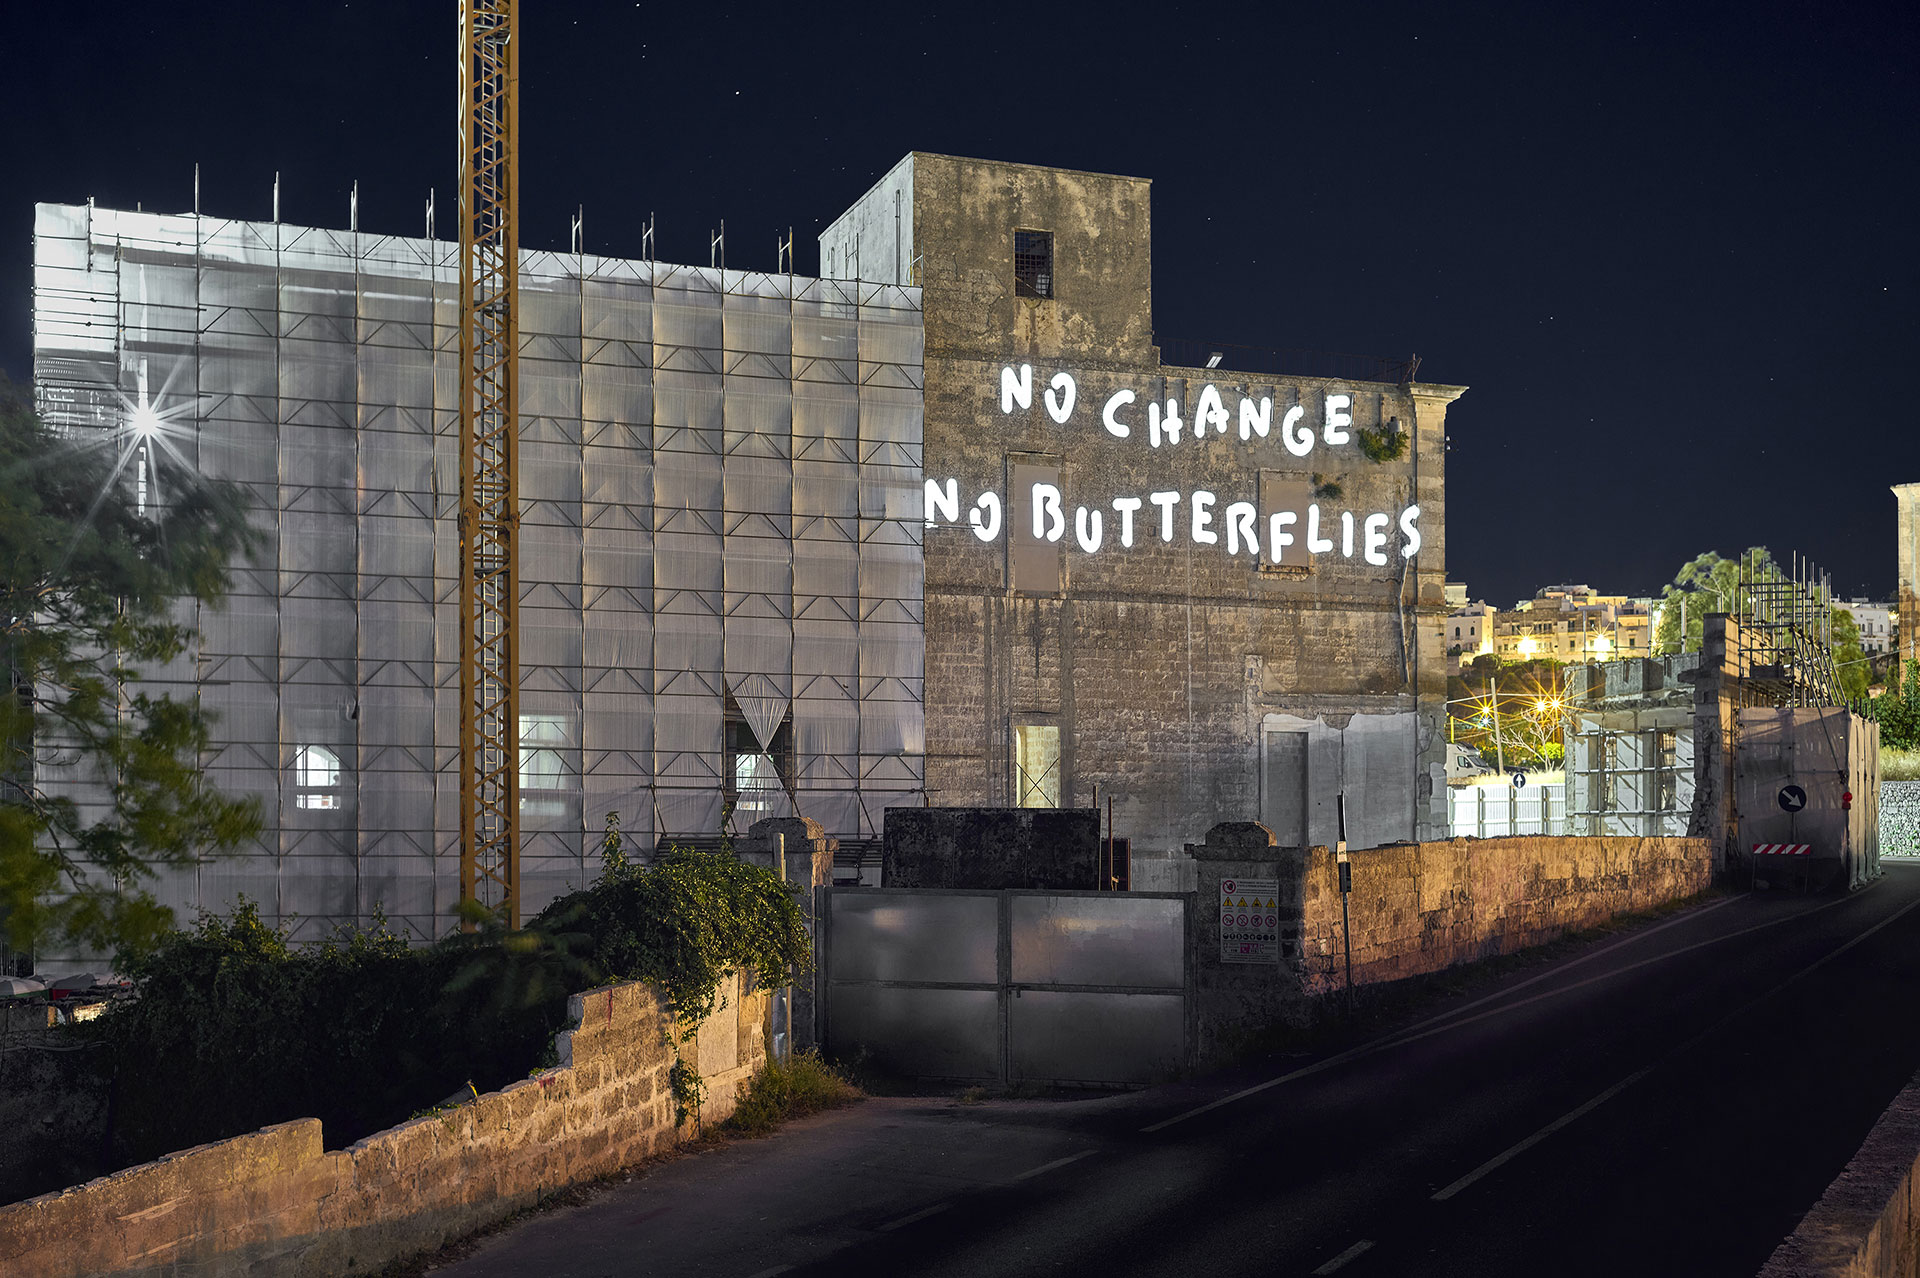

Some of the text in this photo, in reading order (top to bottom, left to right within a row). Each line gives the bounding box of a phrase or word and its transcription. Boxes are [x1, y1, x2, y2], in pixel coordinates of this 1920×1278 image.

[1001, 364, 1351, 457] NO CHANGE
[924, 478, 1421, 565] NO BUTTERFLIES
